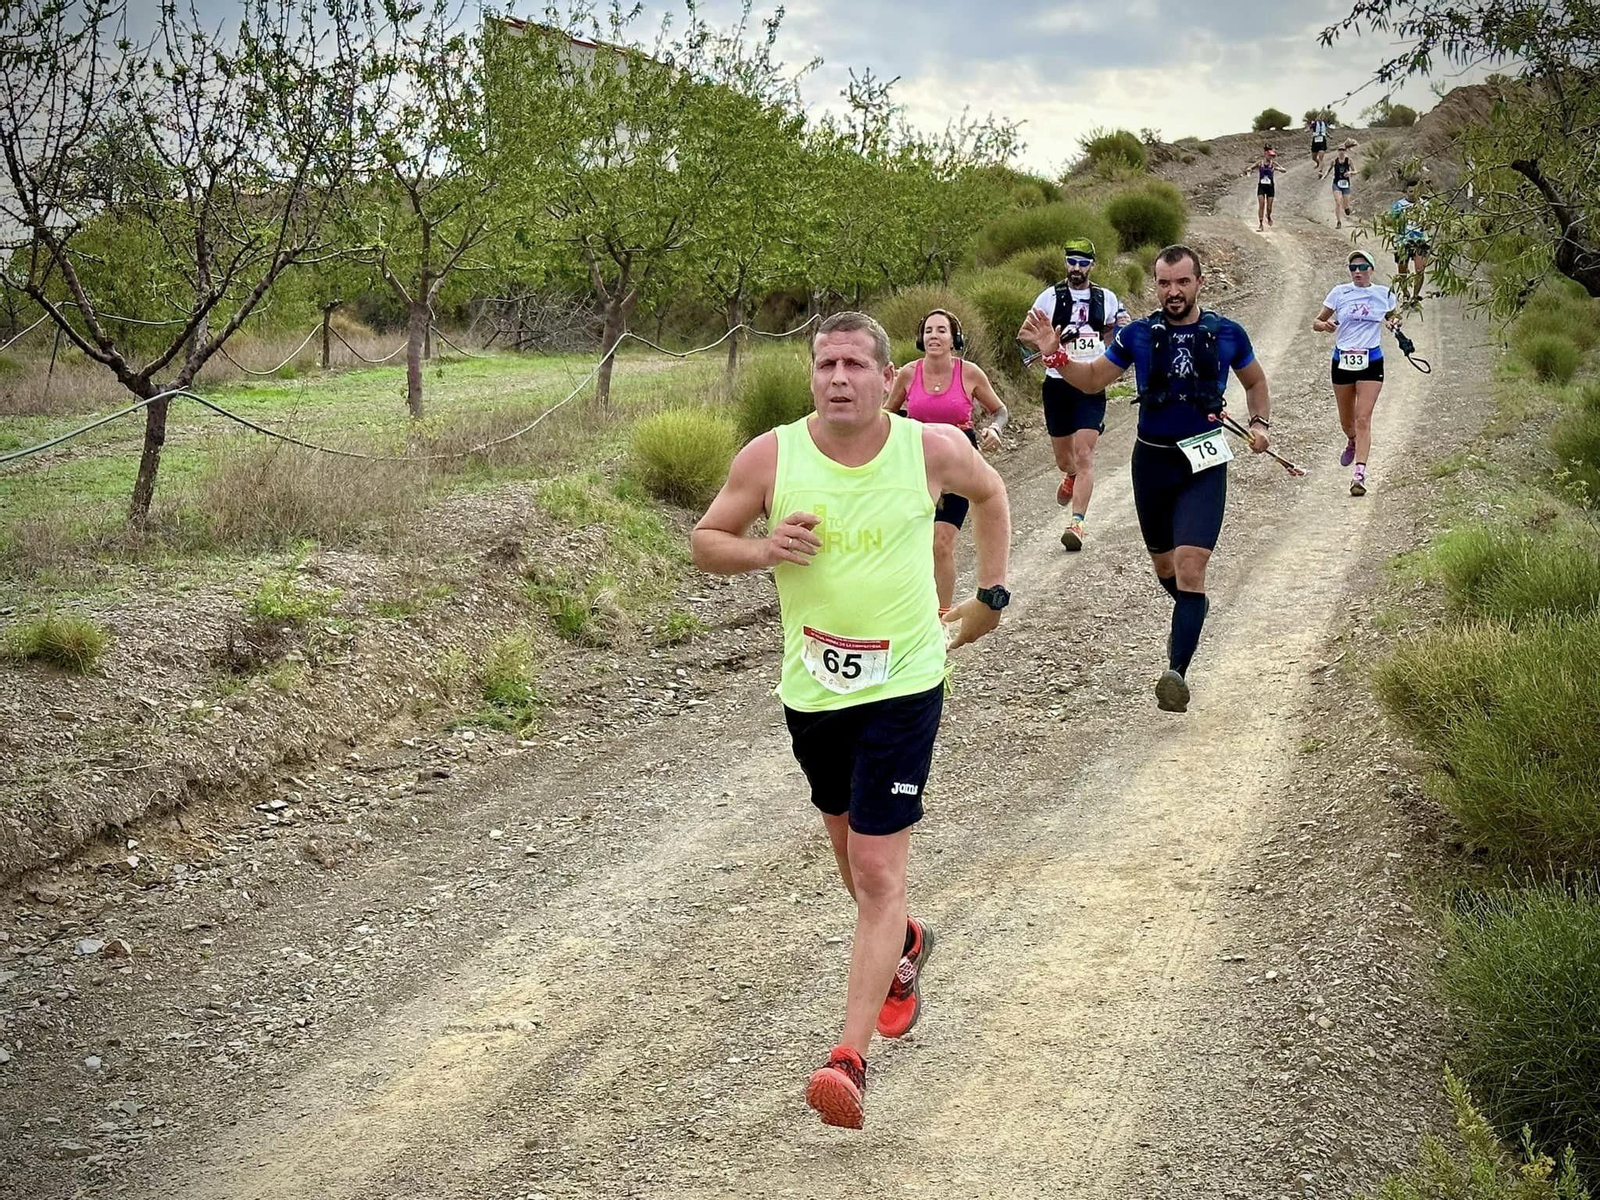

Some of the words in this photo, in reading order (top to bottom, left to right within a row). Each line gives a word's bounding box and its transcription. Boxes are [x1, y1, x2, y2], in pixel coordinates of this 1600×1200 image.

[1073, 338, 1094, 350] 134
[1343, 355, 1363, 365] 133
[1192, 441, 1217, 459] 78
[828, 517, 844, 528] TO
[826, 527, 882, 553] RUN
[823, 649, 862, 679] 65
